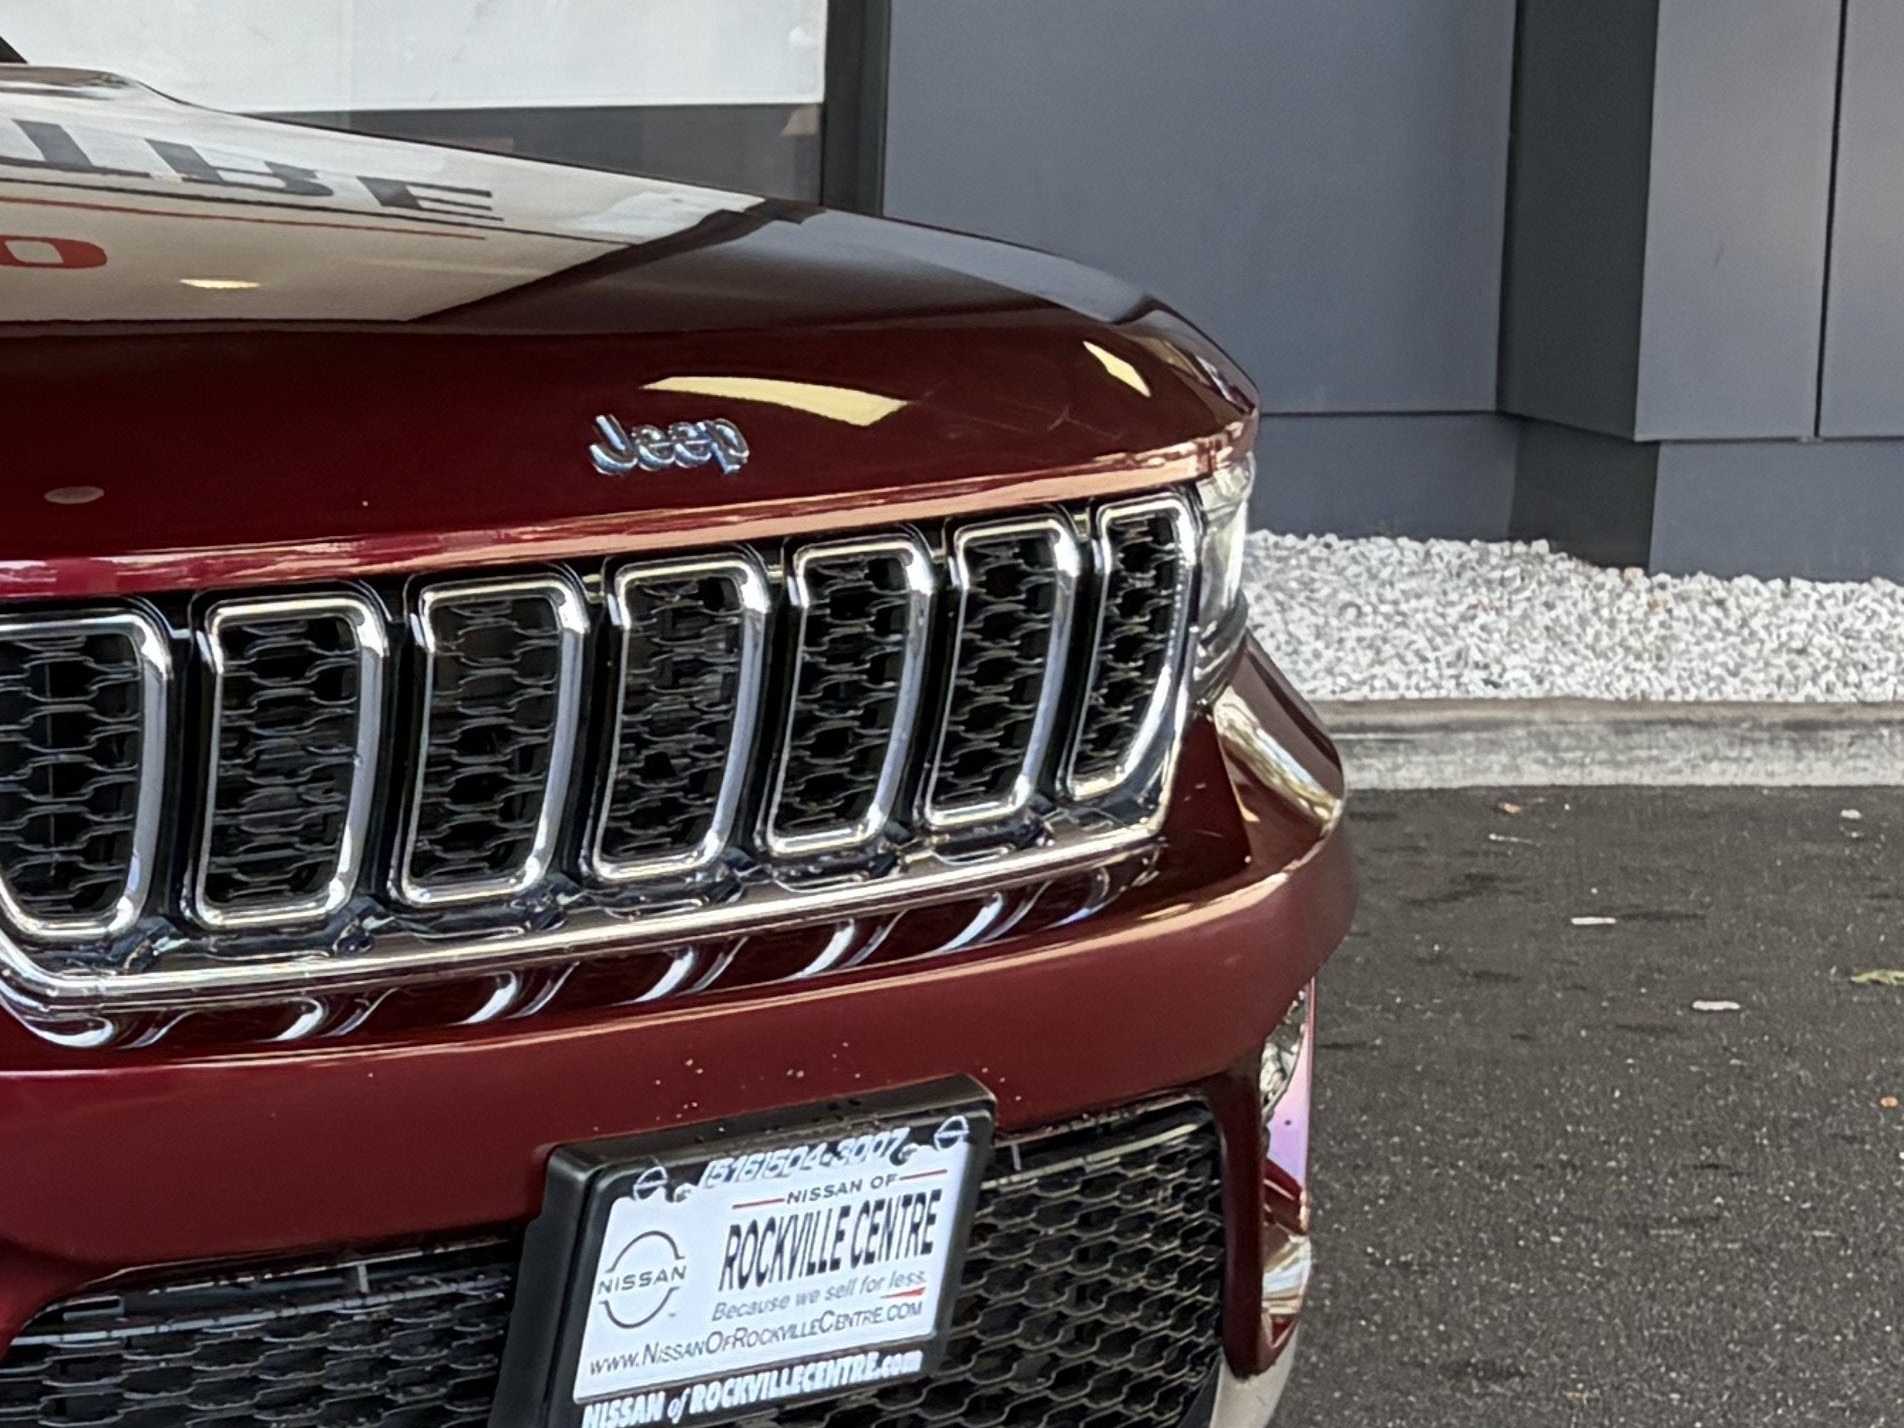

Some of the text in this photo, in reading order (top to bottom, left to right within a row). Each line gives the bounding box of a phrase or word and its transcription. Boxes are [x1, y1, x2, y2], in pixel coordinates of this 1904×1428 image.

[590, 413, 750, 475] Jeep
[786, 1173, 898, 1206] NISSAN OF
[717, 1189, 943, 1293] ROCKVILLE CENTRE
[597, 1265, 687, 1295] NISSAN
[711, 1294, 789, 1322] Because
[795, 1287, 820, 1306] we
[824, 1276, 857, 1302] sell
[858, 1272, 887, 1297] for
[667, 1388, 692, 1424] of
